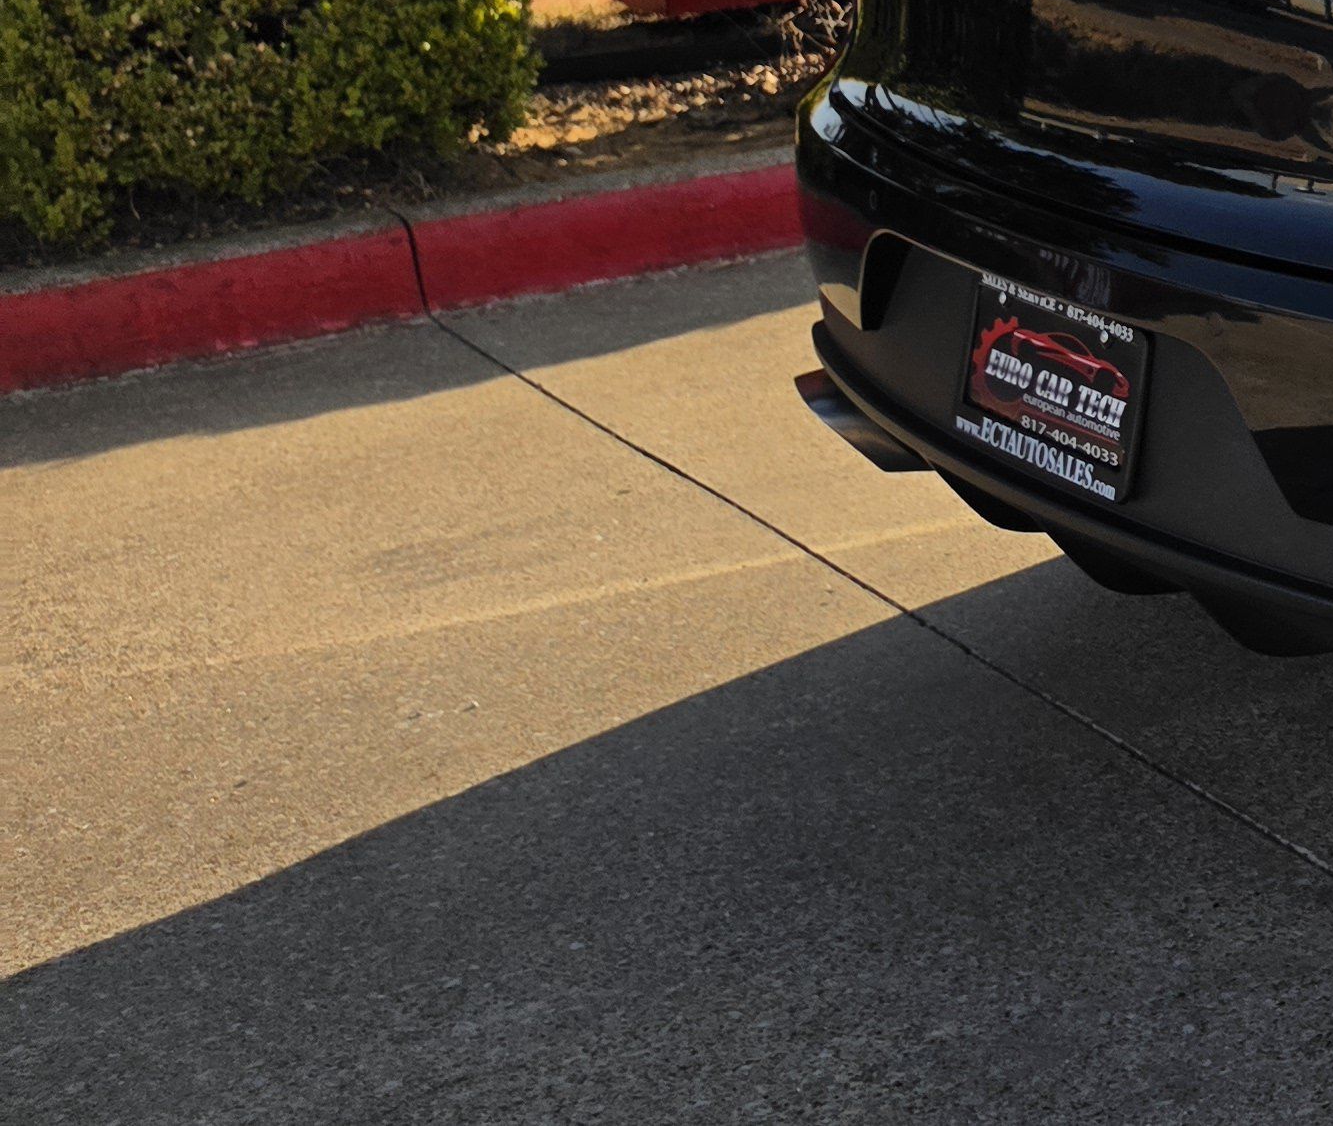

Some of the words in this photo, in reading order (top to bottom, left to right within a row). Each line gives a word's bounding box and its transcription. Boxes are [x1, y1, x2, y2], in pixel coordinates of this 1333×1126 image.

[981, 273, 1008, 293] SALES
[1017, 287, 1057, 312] SERVICE
[1066, 305, 1134, 343] 817-404-4033
[985, 348, 1033, 390] EURO
[1035, 369, 1073, 408] CAR
[1077, 385, 1127, 428] TECH
[1023, 393, 1066, 421] european
[1066, 407, 1121, 442] automotive
[956, 415, 1116, 502] www.ECTAUTOSALES.com
[1021, 414, 1119, 467] 817-404-4033
